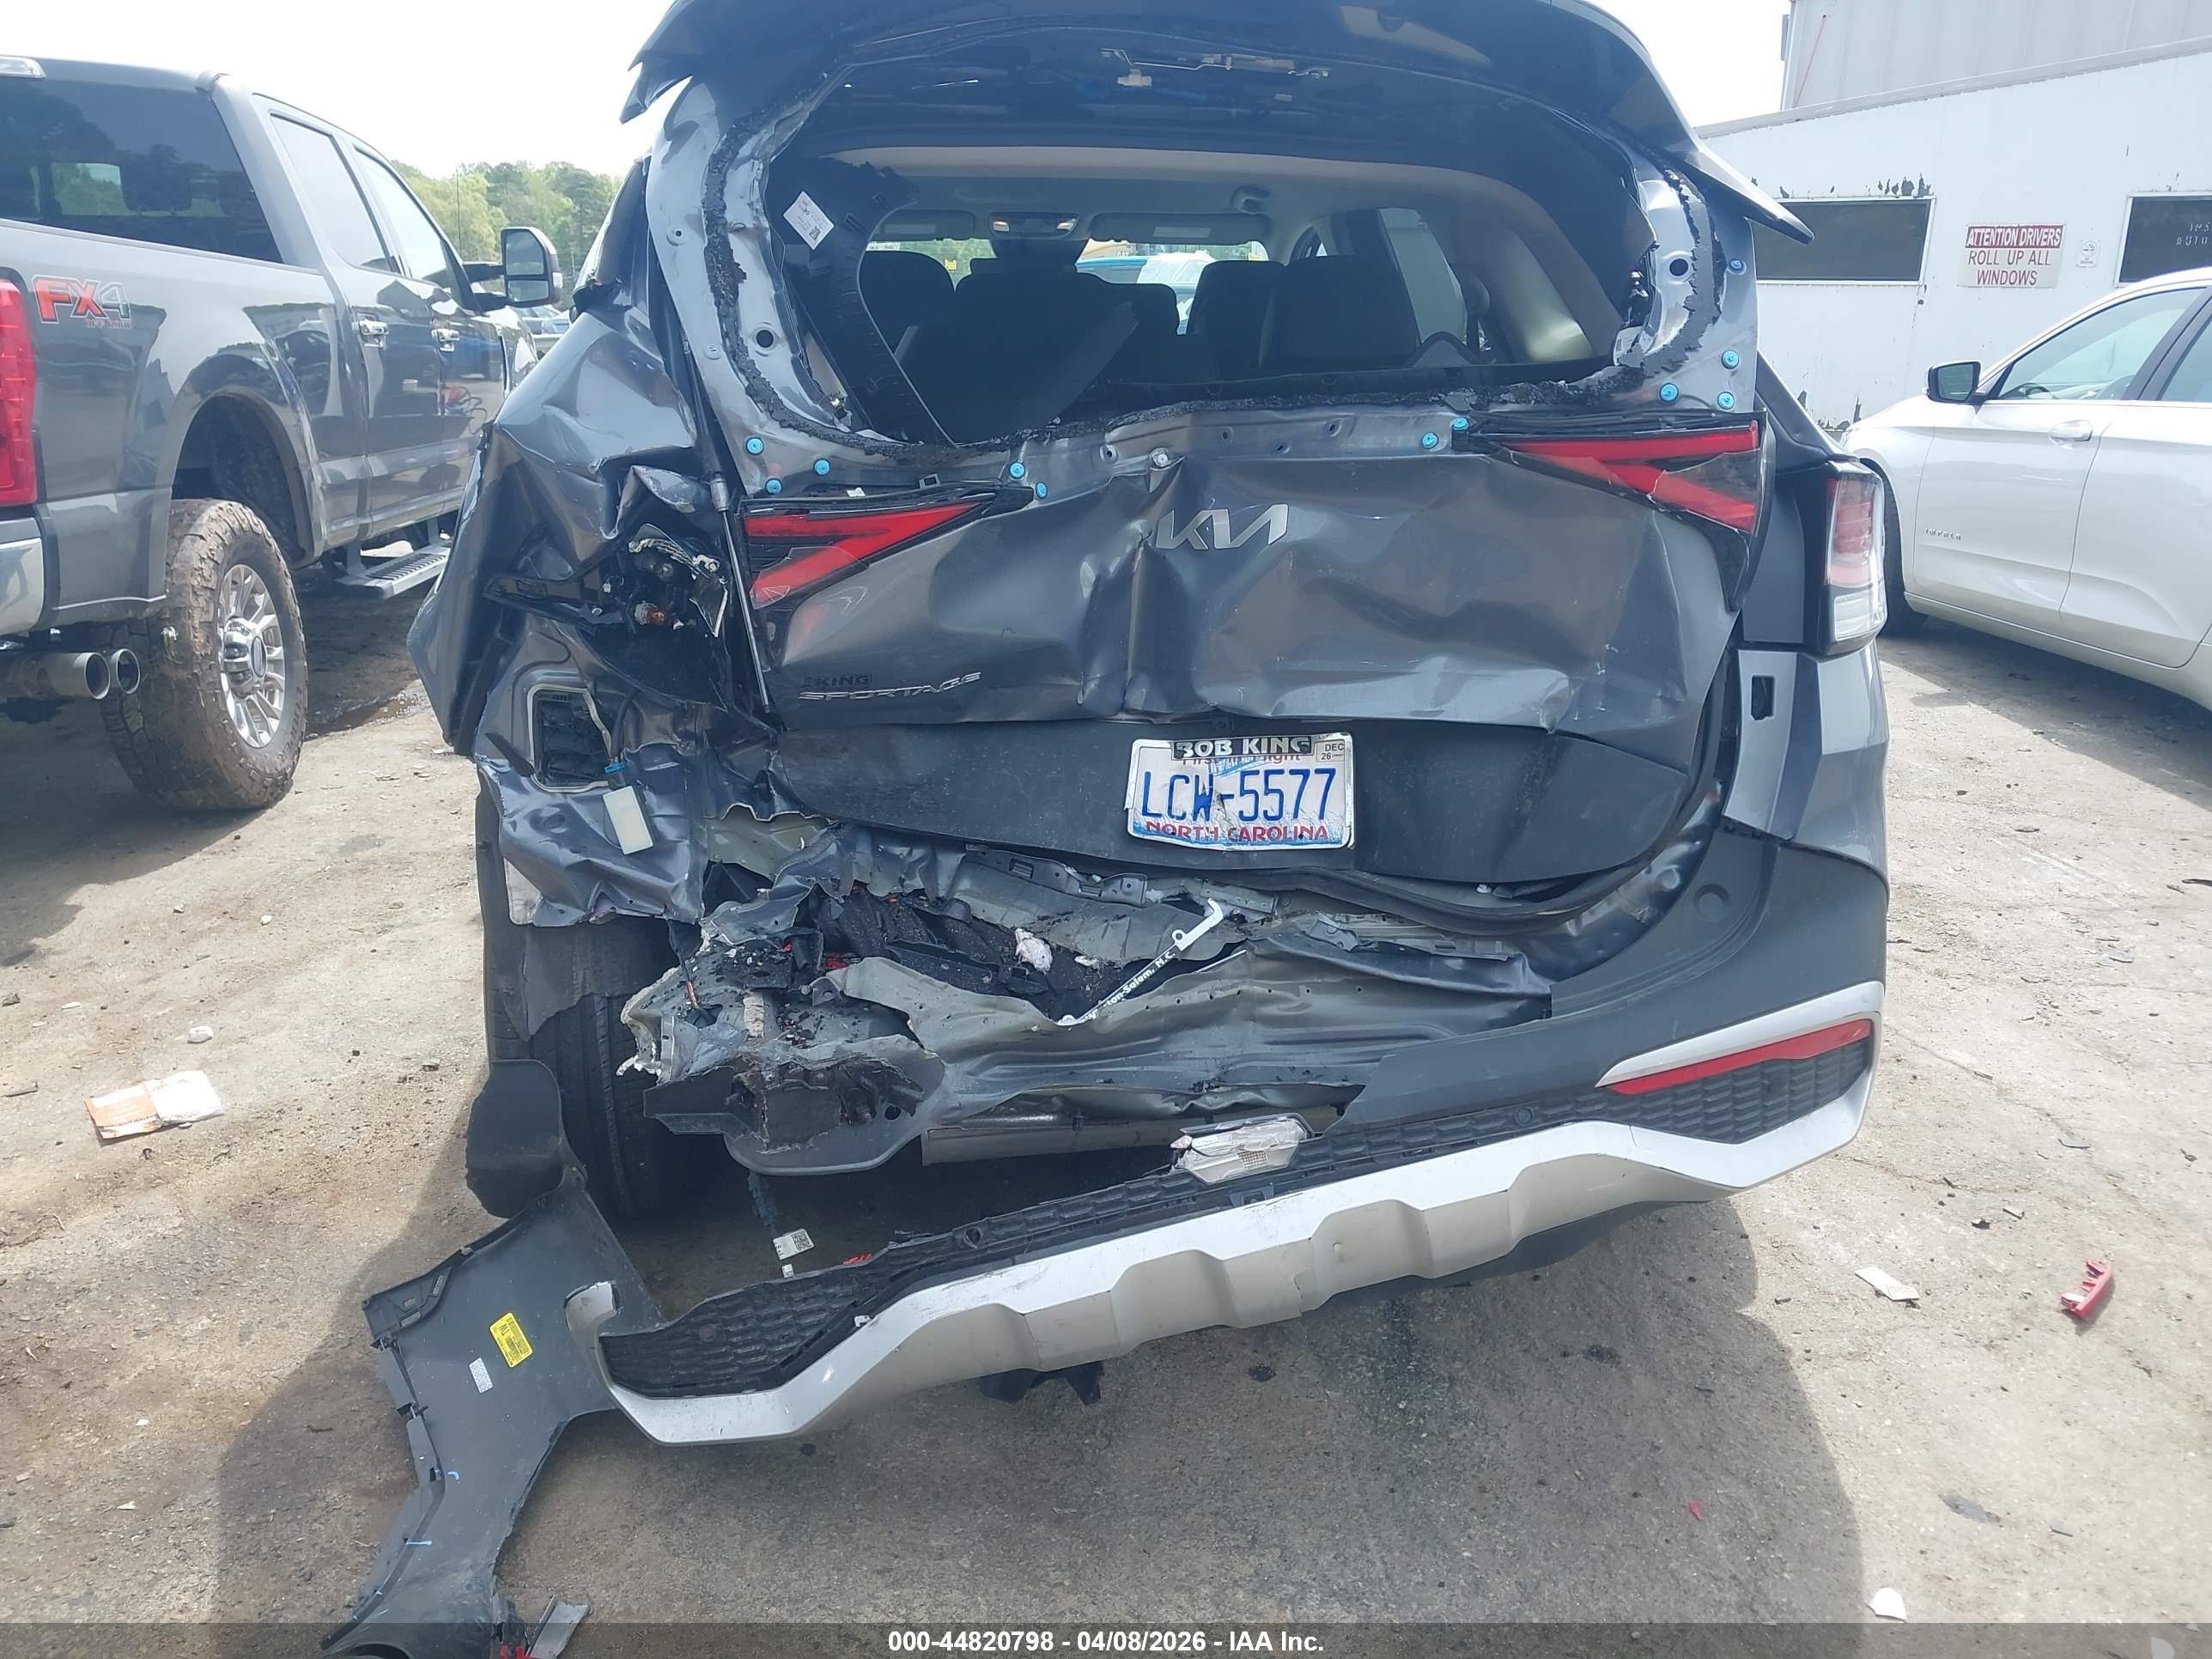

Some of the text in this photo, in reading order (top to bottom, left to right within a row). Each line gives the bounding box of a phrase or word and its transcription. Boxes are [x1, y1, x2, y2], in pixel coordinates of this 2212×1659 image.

[1966, 227, 2061, 246] ATTENTION DRIVERS
[1968, 249, 2051, 266] ROLL UP ALL
[1977, 270, 2039, 286] WINDOWS
[32, 274, 131, 324] FX4
[798, 672, 981, 701] SPORTAGE
[1176, 737, 1310, 757] BOB KING
[1321, 752, 1332, 761] 26
[1325, 743, 1345, 751] DEC
[1141, 768, 1337, 822] LCW-5577
[1146, 821, 1329, 842] NORTH CAROLINA
[1155, 951, 1176, 969] N.C.
